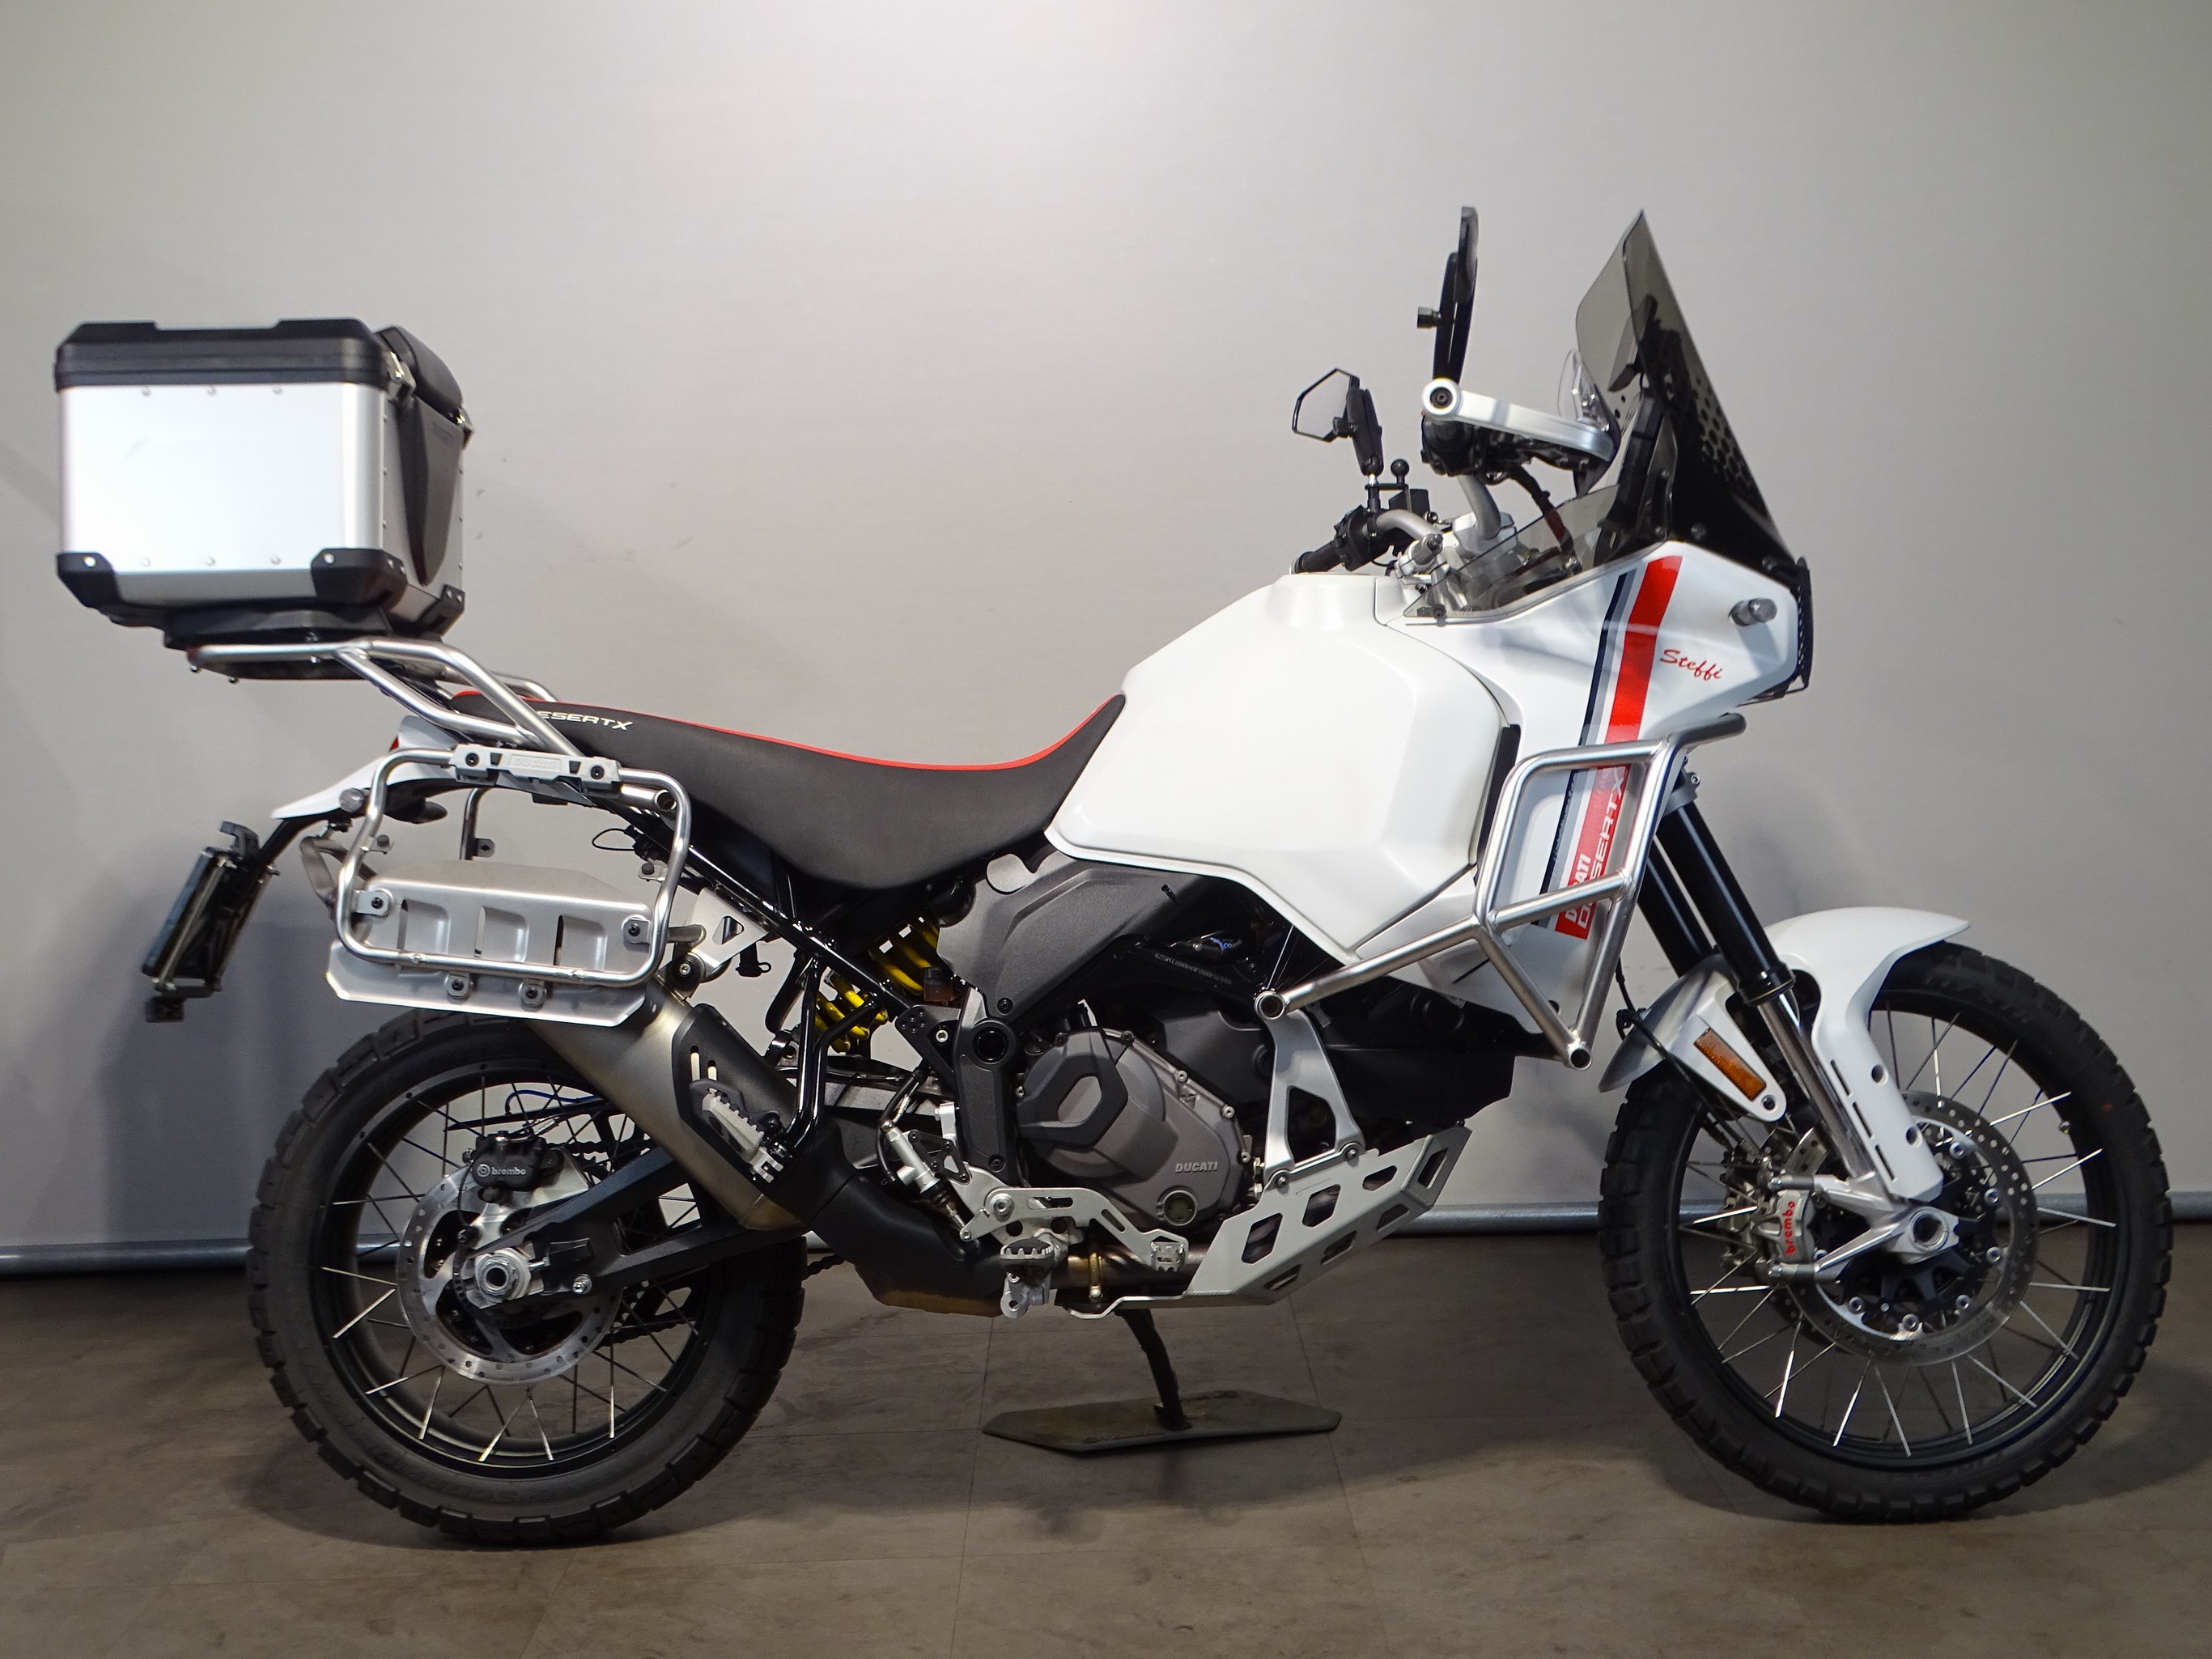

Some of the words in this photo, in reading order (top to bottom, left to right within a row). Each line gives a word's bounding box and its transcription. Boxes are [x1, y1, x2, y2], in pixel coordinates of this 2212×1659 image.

[1659, 648, 1723, 681] Steffi
[536, 711, 633, 731] ESERTX
[1577, 766, 1624, 930] DSERTX
[1565, 853, 1592, 923] DATI
[490, 1166, 527, 1177] brembo
[1174, 1160, 1218, 1173] DUCATI
[1781, 1200, 1796, 1255] brembo
